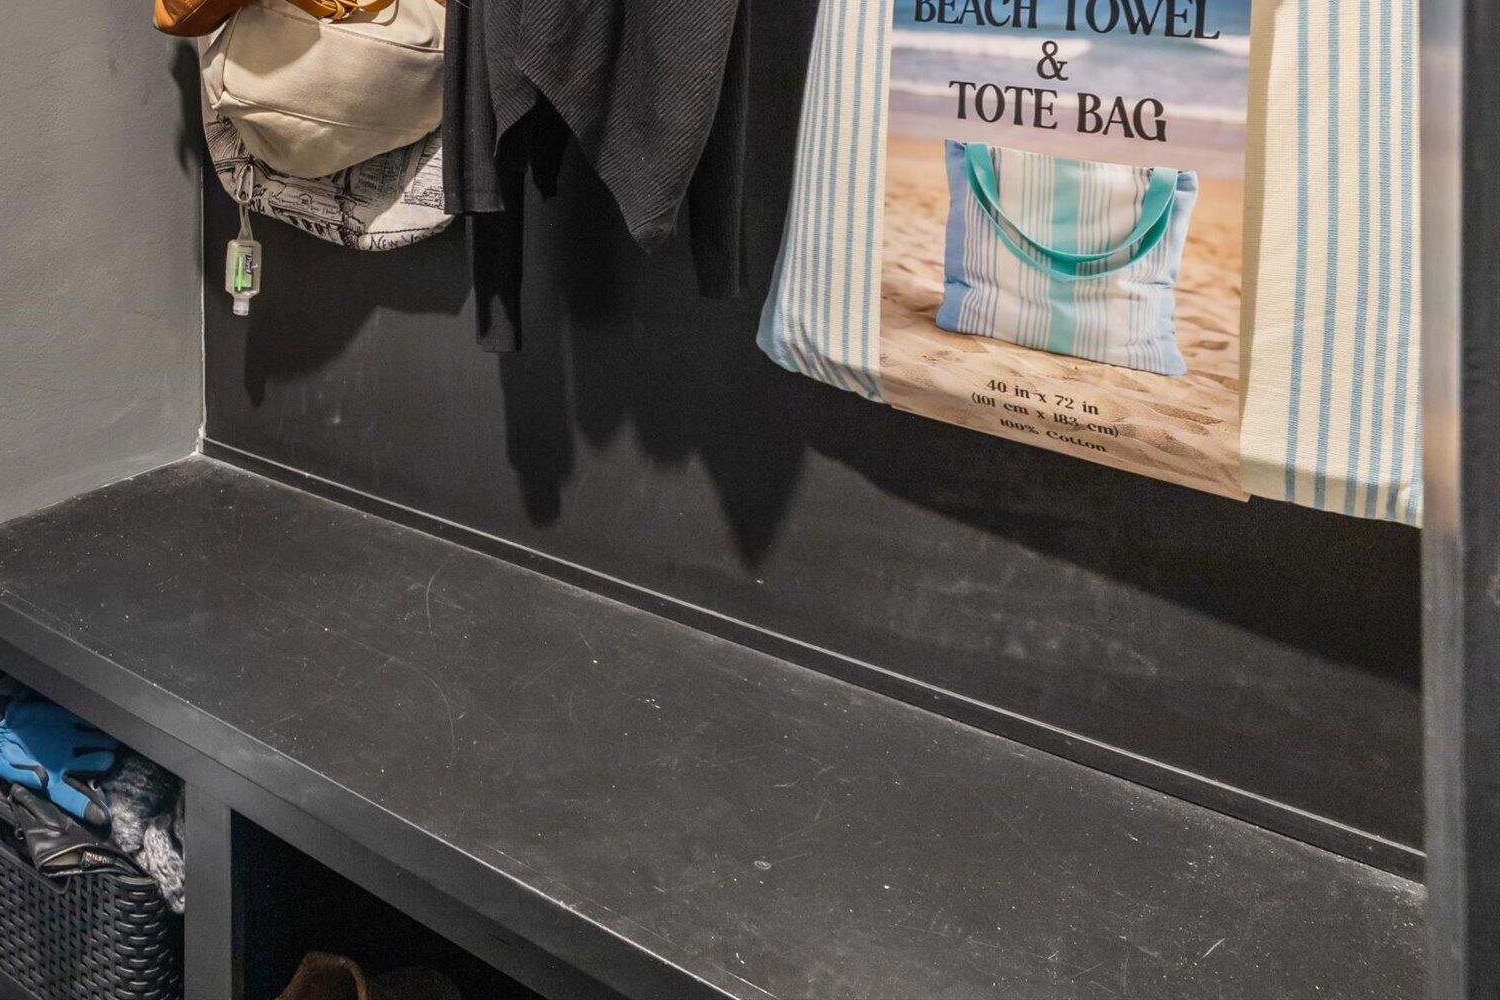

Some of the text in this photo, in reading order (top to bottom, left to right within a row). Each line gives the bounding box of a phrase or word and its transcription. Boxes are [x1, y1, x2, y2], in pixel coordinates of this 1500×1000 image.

[1036, 40, 1069, 81] &
[949, 81, 1167, 142] TOTE BAG
[972, 392, 1119, 438] (101 cm x 183 cm)
[987, 380, 1099, 415] 40 in x 72 in
[1000, 418, 1107, 452] 100% Cotton
